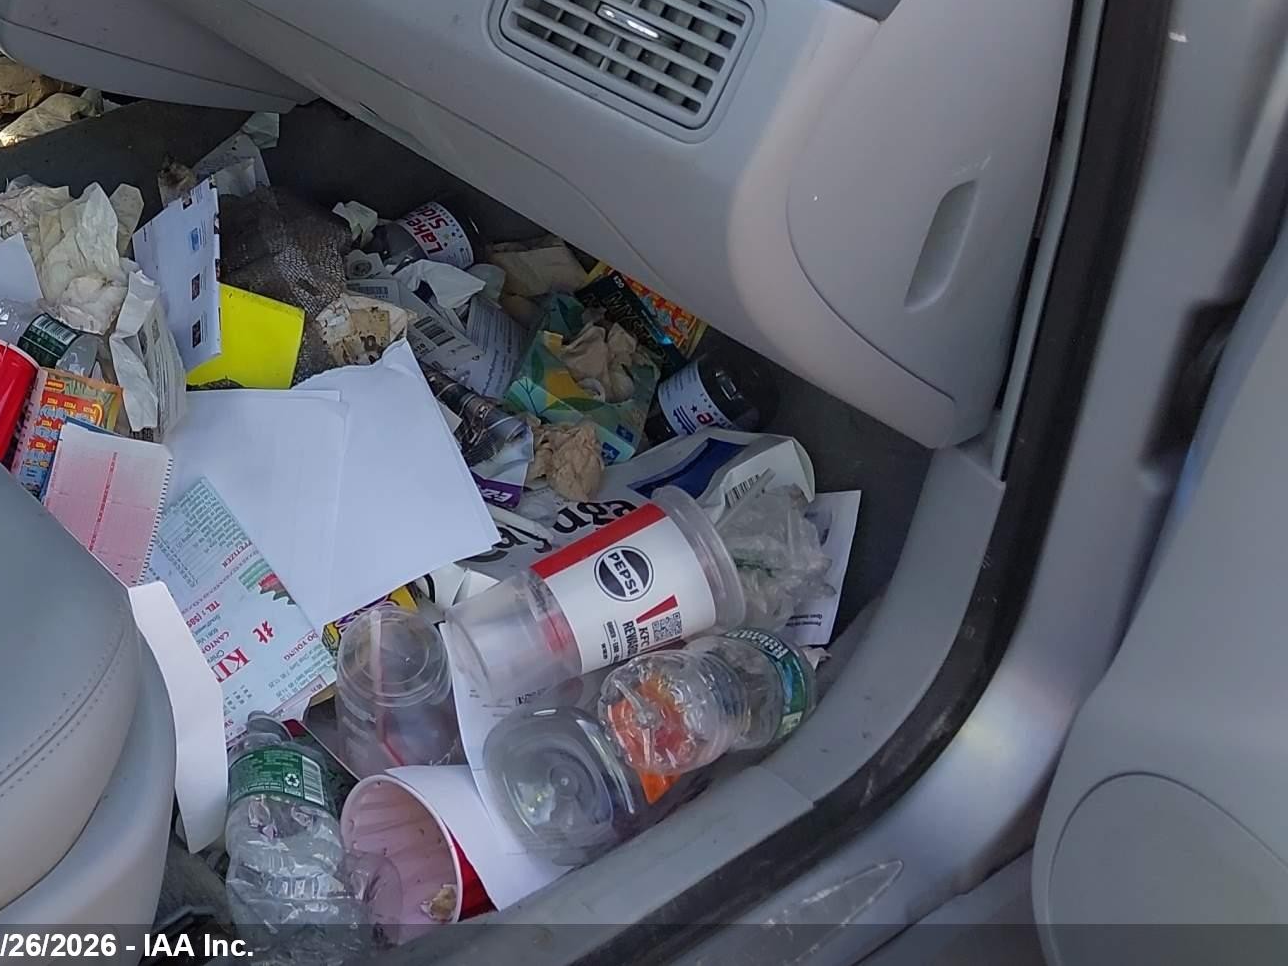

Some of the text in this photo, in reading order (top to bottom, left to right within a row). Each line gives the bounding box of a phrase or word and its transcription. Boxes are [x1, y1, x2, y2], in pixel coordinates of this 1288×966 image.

[405, 216, 443, 254] Lake
[606, 551, 639, 595] PEPSI
[250, 619, 278, 647] 北
[638, 626, 650, 647] KFC
